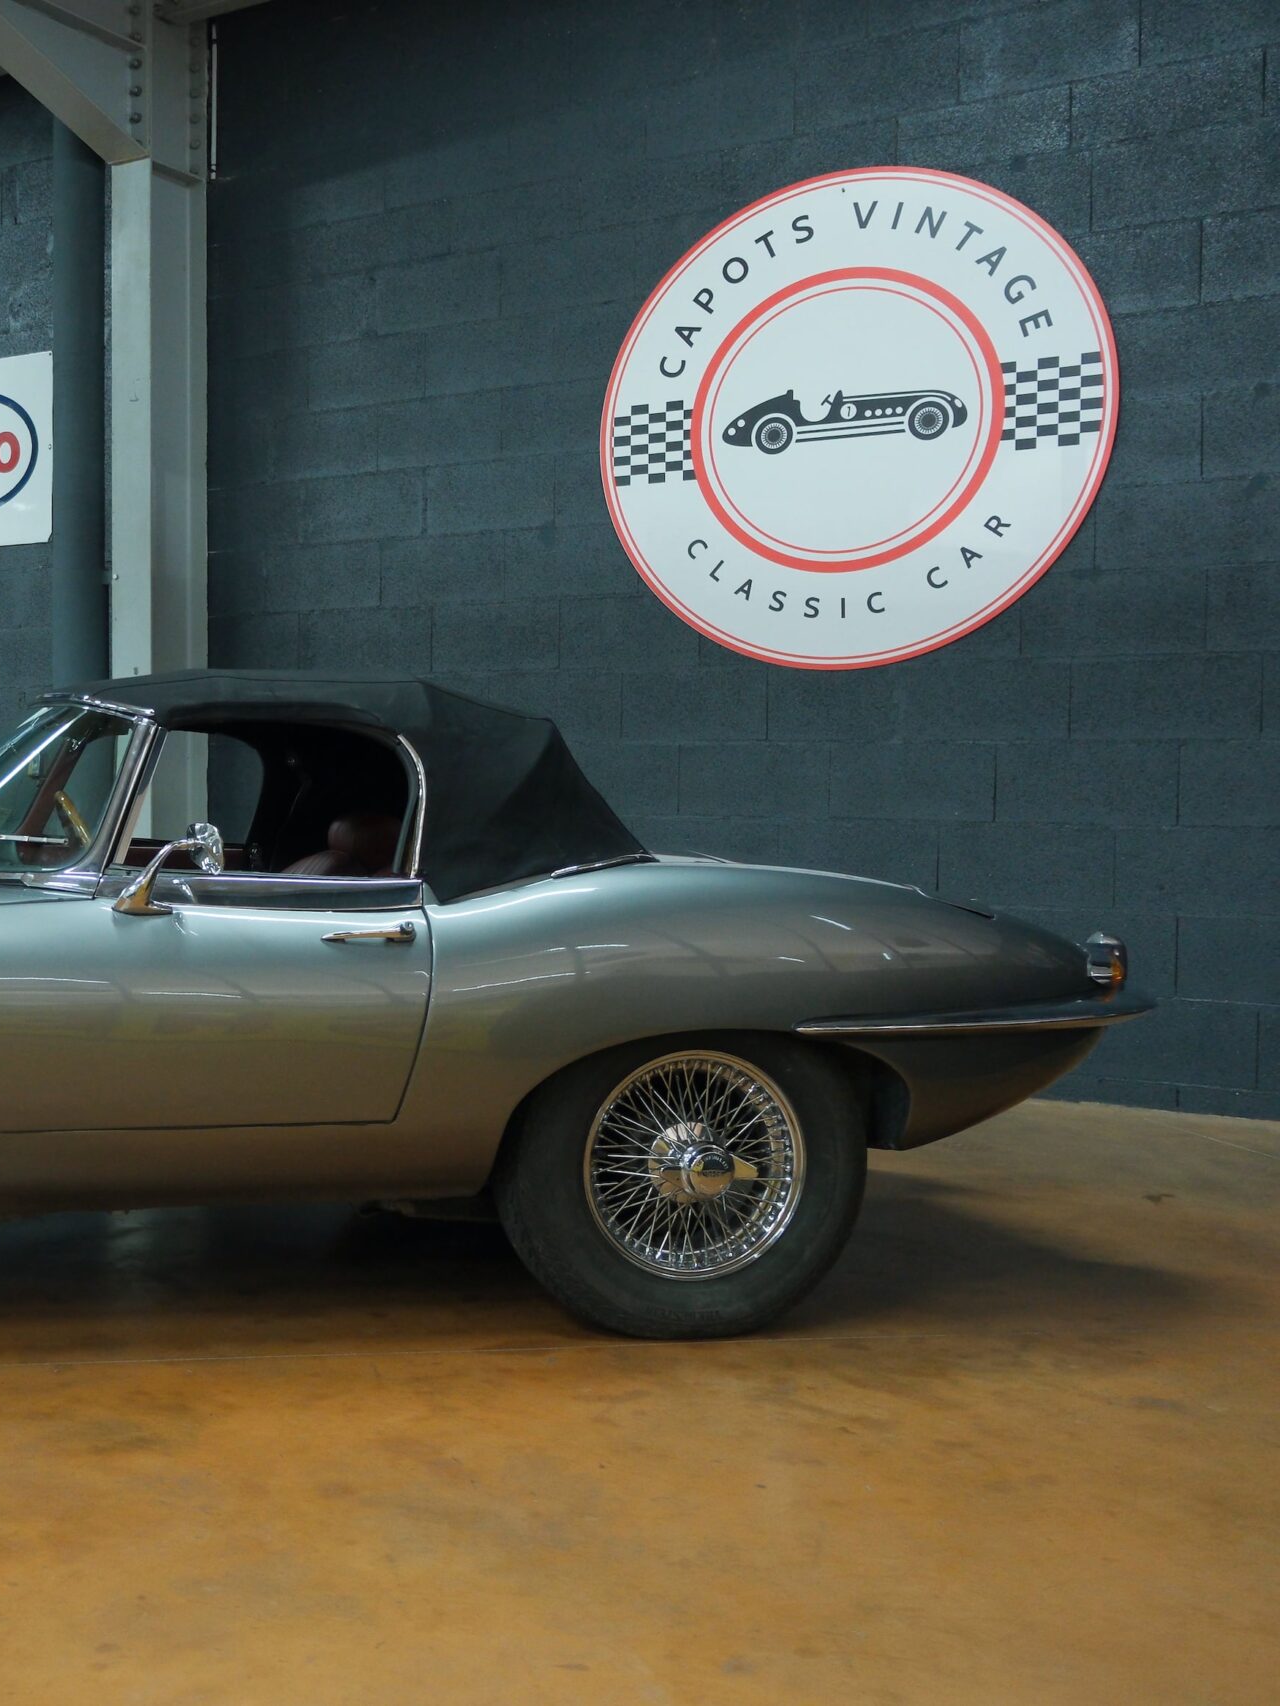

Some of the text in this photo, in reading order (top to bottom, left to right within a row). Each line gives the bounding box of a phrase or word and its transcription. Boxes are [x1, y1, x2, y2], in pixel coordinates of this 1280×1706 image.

[659, 200, 1054, 378] CAPOTS VINTAGE
[687, 514, 1012, 619] CLASSIC CAR
